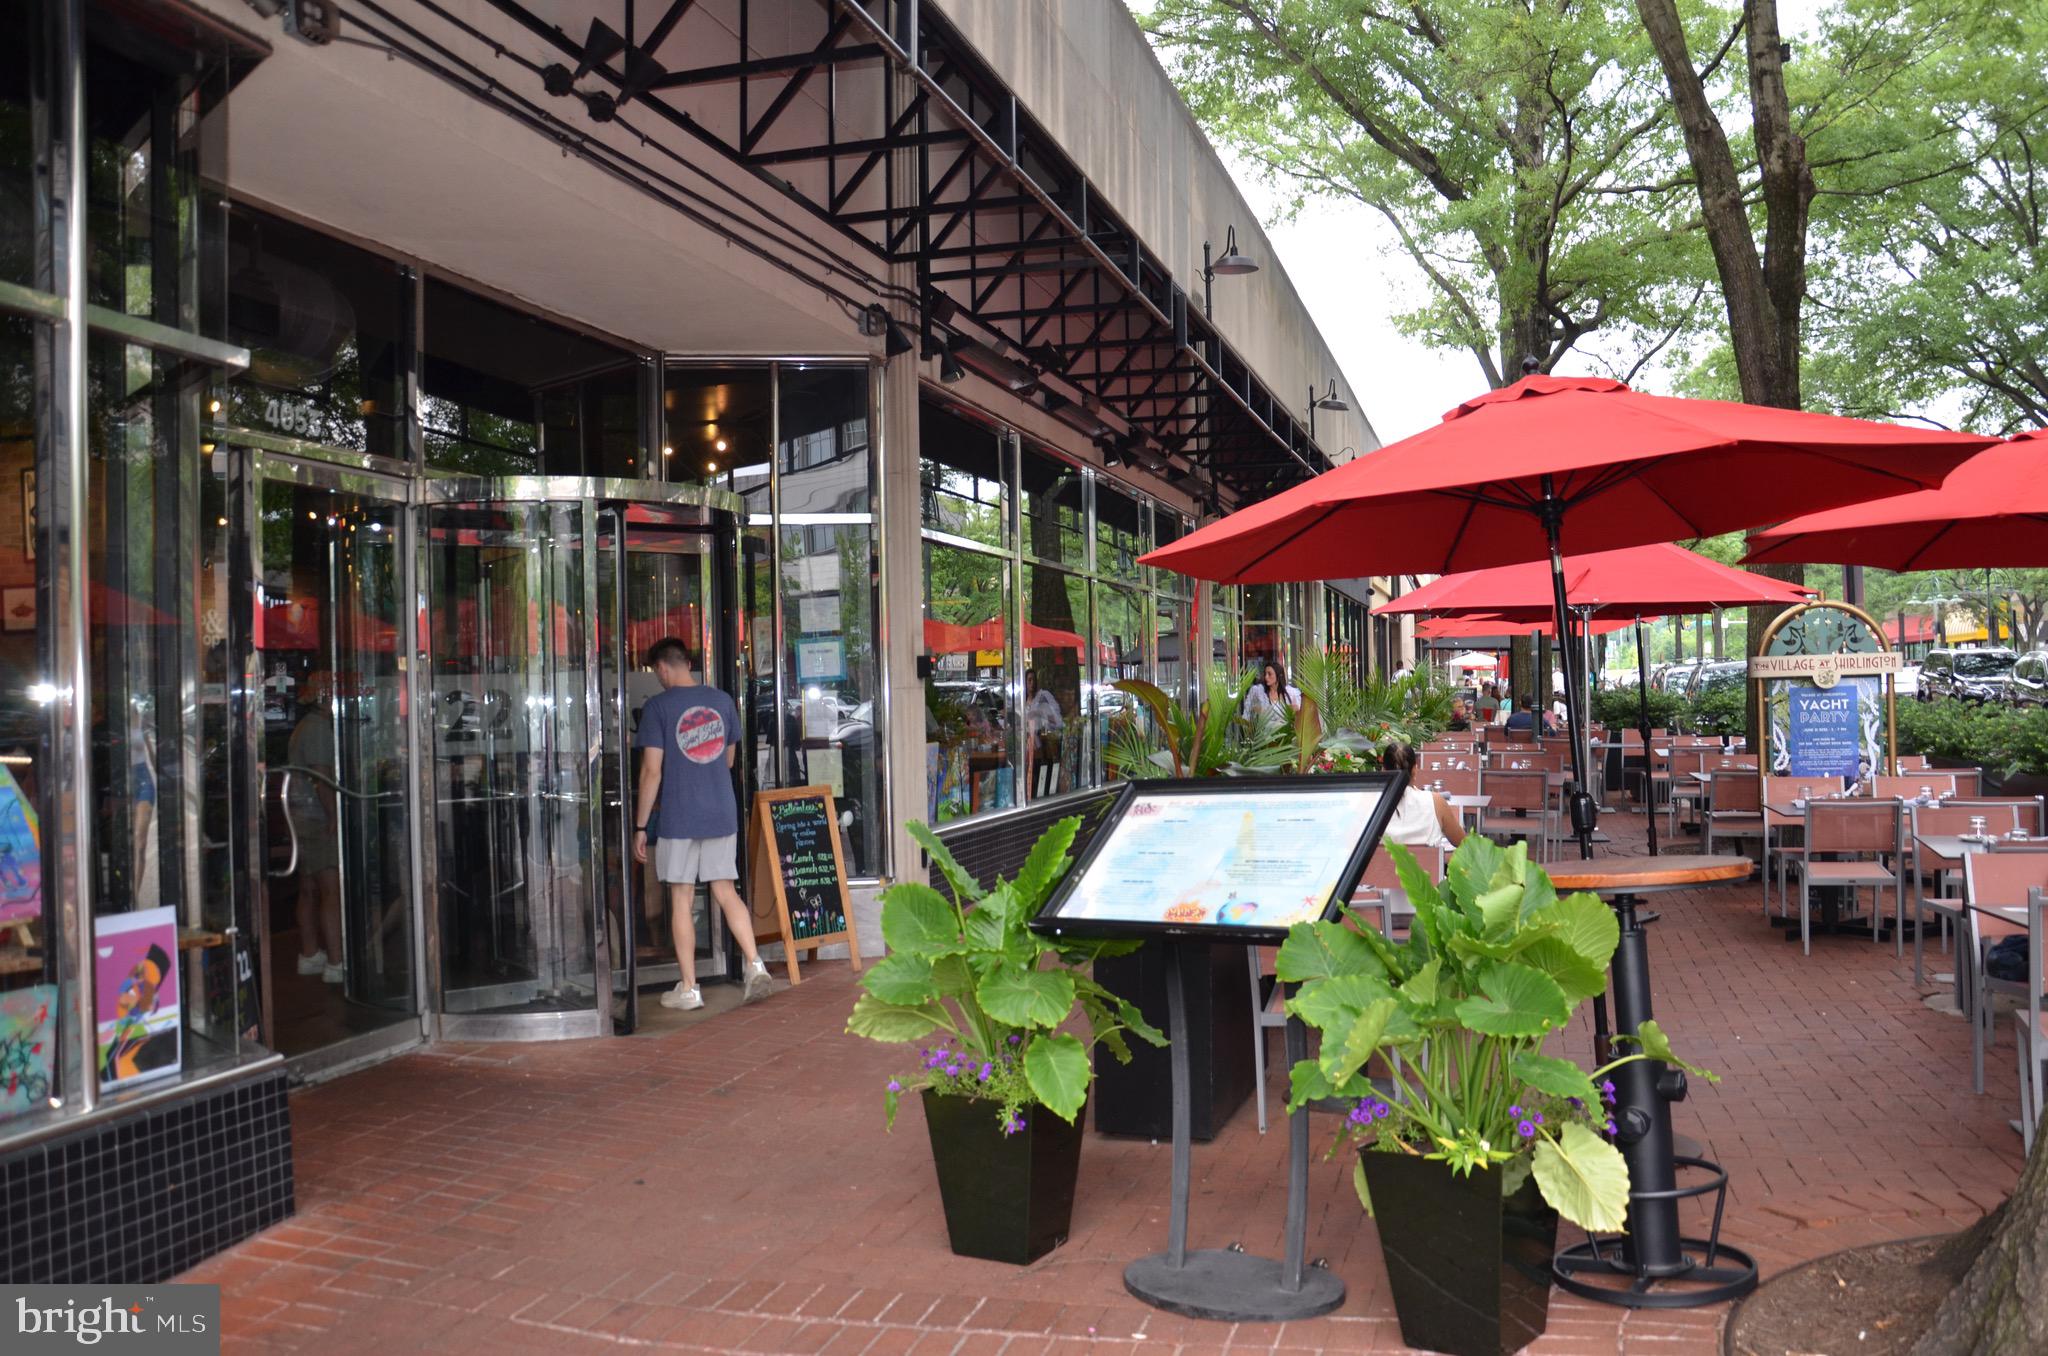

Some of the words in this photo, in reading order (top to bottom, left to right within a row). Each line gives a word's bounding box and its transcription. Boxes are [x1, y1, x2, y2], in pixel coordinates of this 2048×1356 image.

[265, 399, 322, 437] 4053
[1770, 658, 1815, 671] VILLAGE
[1819, 660, 1829, 668] AT
[1834, 655, 1897, 670] SHIRLINGTON
[1800, 699, 1849, 711] YACHT
[1800, 711, 1850, 723] PARTY
[792, 851, 813, 864] Lunch
[792, 863, 818, 876] Brunch
